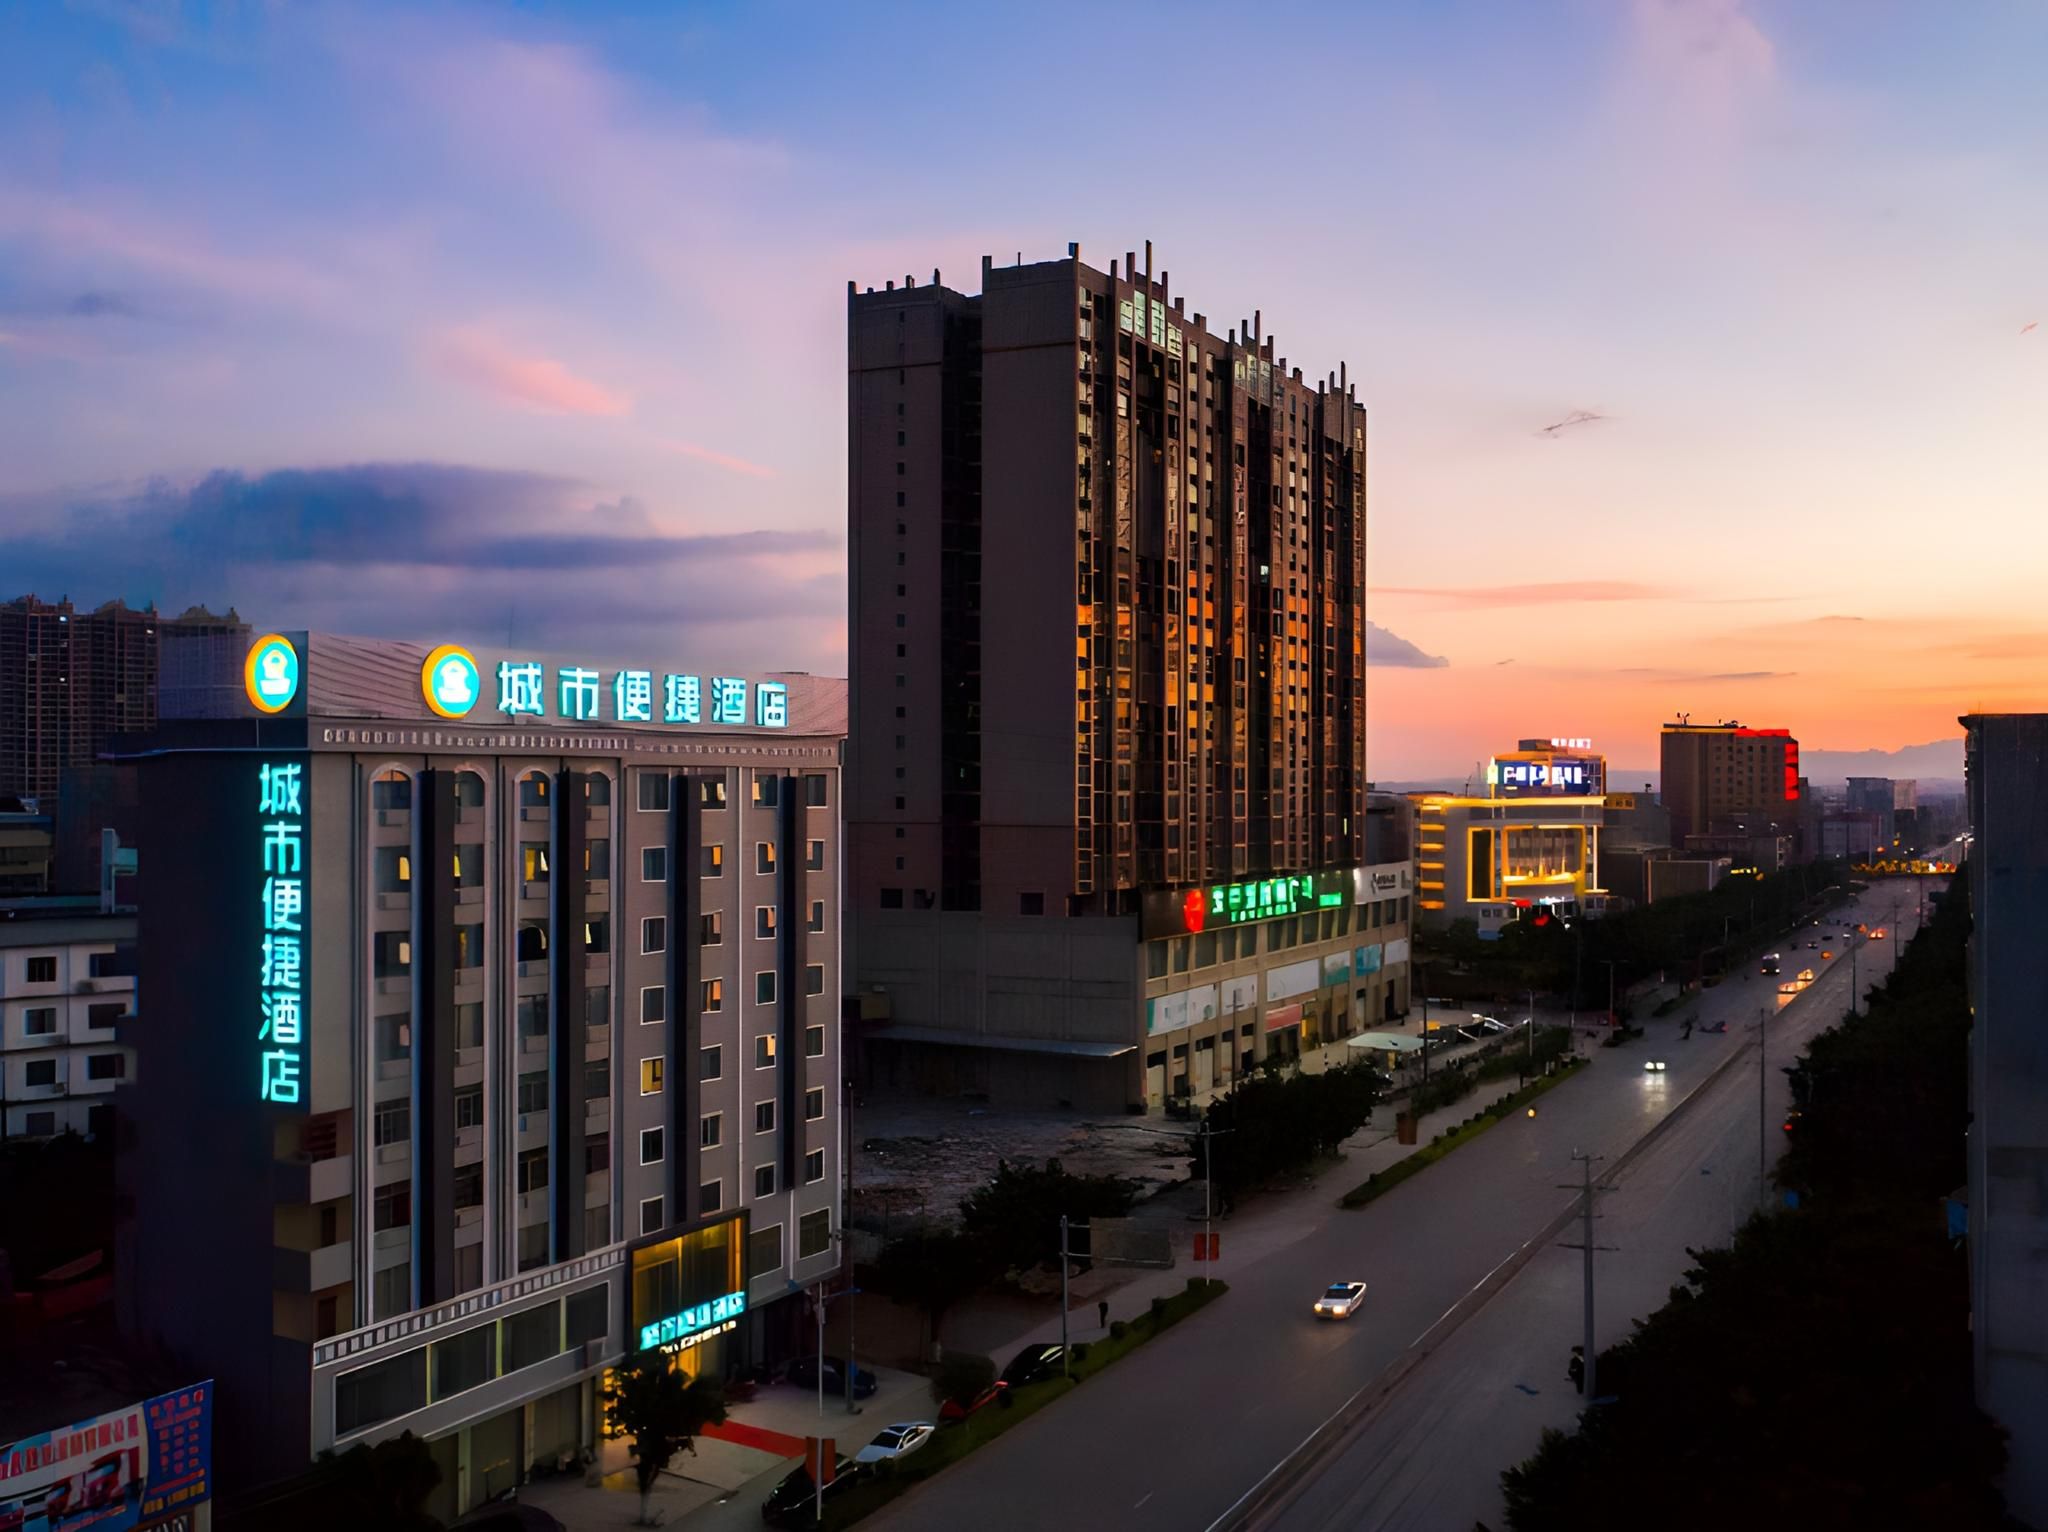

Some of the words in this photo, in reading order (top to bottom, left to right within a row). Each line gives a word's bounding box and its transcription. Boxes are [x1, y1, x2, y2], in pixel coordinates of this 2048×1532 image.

[497, 661, 789, 727] 城市便捷酒店
[258, 763, 303, 1104] 城市便捷酒店
